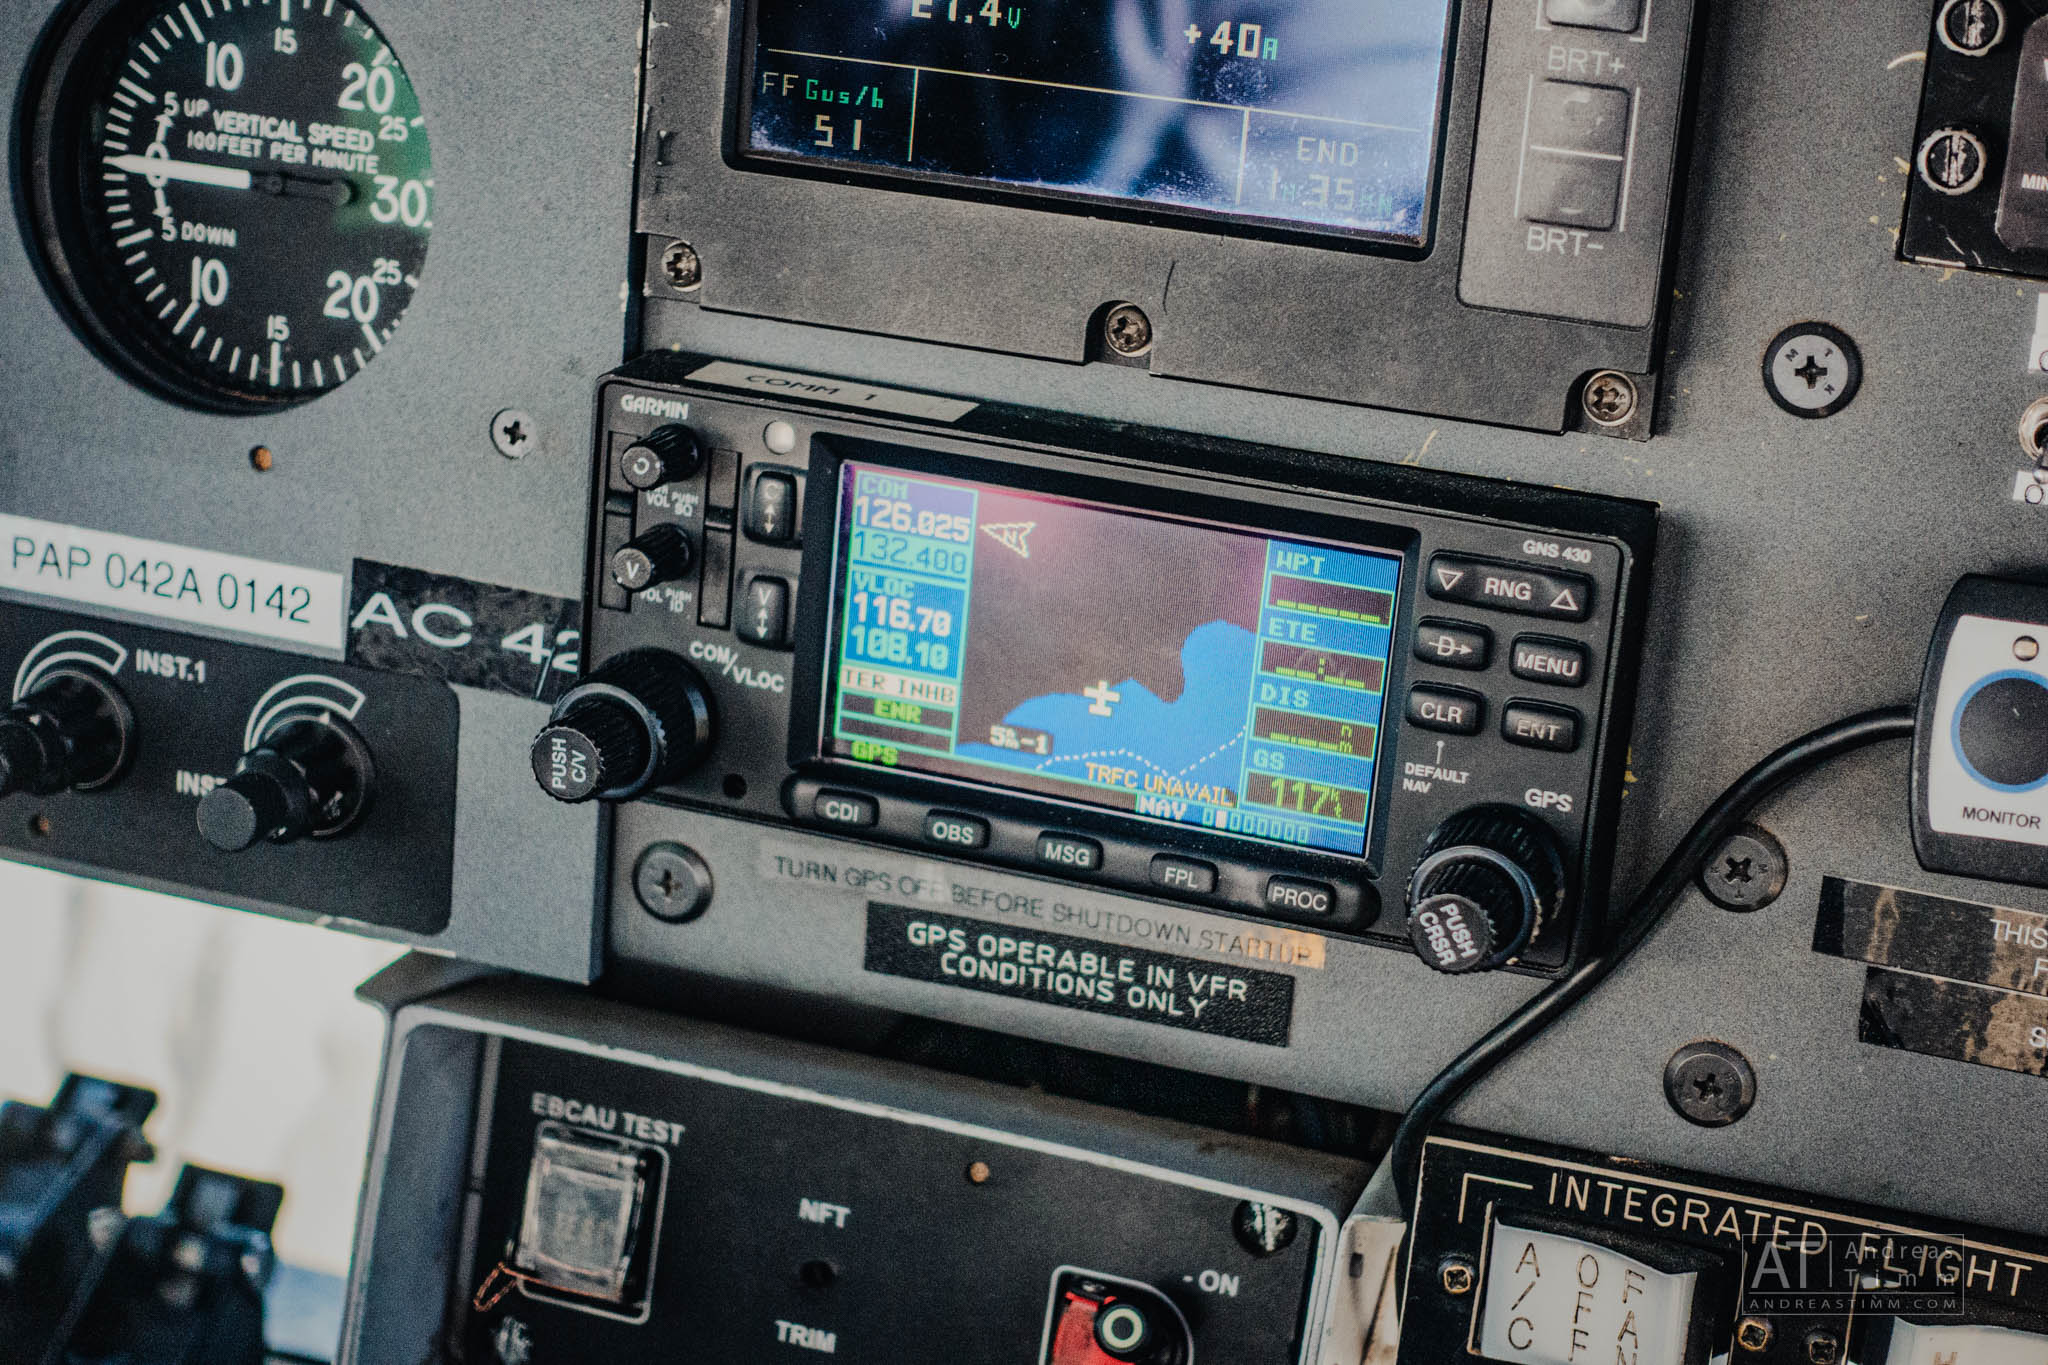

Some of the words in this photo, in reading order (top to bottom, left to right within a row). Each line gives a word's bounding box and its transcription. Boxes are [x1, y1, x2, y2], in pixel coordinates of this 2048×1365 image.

[274, 28, 297, 54] 15
[206, 42, 245, 90] 10
[1547, 46, 1625, 76] BRT+
[337, 63, 395, 113] 20
[762, 72, 799, 97] FF
[164, 91, 180, 117] 5
[184, 98, 210, 118] UP
[213, 110, 303, 144] VERTICAL
[308, 122, 375, 153] SPEED
[378, 115, 409, 142] 25
[270, 141, 307, 164] PER
[312, 149, 380, 174] MINUTE
[1298, 135, 1359, 167] END
[370, 174, 427, 227] 30
[161, 218, 178, 243] 5
[181, 221, 237, 248] DOWN
[191, 255, 229, 307] 10
[373, 258, 402, 286] 25
[323, 271, 379, 324] 20
[266, 315, 290, 342] 15
[746, 374, 841, 396] COMM
[621, 394, 689, 420] GARMIN
[646, 493, 671, 508] VOL
[861, 476, 909, 500] COM
[856, 495, 971, 543] 126.025
[854, 530, 967, 574] 132.400
[1276, 550, 1326, 576] WPT
[1522, 539, 1560, 559] GNS
[1562, 547, 1592, 564] 430
[12, 536, 91, 582] PAP
[105, 552, 202, 605] 042A
[217, 573, 312, 625] 0142
[626, 560, 639, 580] V
[854, 570, 915, 598] VLOC
[1484, 577, 1532, 601] RNG
[351, 592, 473, 649] AC
[852, 593, 952, 638] 116.70
[1268, 617, 1317, 643] ETE
[851, 627, 950, 670] 108.10
[135, 648, 206, 684] INST.1
[1516, 652, 1578, 677] MENU
[1261, 683, 1309, 709] DIS
[874, 698, 922, 724] ENR
[1420, 702, 1463, 724] CLR
[1516, 719, 1561, 741] ENT
[552, 737, 567, 790] PUSH
[571, 749, 587, 783] C/V
[851, 741, 899, 766] GPS
[1253, 749, 1285, 771] GS
[176, 770, 228, 797] INS
[1085, 762, 1138, 789] TRFC
[1144, 773, 1235, 808] UNAVAIL
[1402, 778, 1432, 794] NAV
[1404, 762, 1470, 785] DEFAULT
[825, 800, 859, 823] CDI
[1139, 794, 1187, 821] NAV
[1524, 788, 1574, 813] GPS
[1962, 806, 2041, 830] MONITOR
[932, 821, 974, 845] OBS
[1045, 842, 1091, 868] MSG
[1164, 866, 1199, 890] FPL
[775, 855, 838, 883] TURN
[844, 866, 893, 893] GPS
[951, 883, 1044, 919] BEFORE
[1053, 901, 1192, 944] SHUTDOWN
[1200, 930, 1313, 965] STARTUP
[1271, 885, 1328, 912] PROC
[1439, 903, 1478, 958] PUSH
[907, 920, 967, 953] GPS
[977, 934, 1135, 983] OPERABLE
[1146, 964, 1175, 989] IN
[1186, 972, 1248, 1001] VFR
[940, 953, 1115, 1003] CONDITIONS
[1128, 986, 1208, 1019] ONLY
[623, 1112, 685, 1146] TEST
[799, 1198, 851, 1229] NFT
[1549, 1172, 1828, 1255] INTEGRATED
[1858, 1232, 2033, 1297] FLIGHT
[1199, 1270, 1240, 1298] ON
[1567, 1254, 1600, 1362] OFF
[775, 1320, 837, 1353] TRIM
